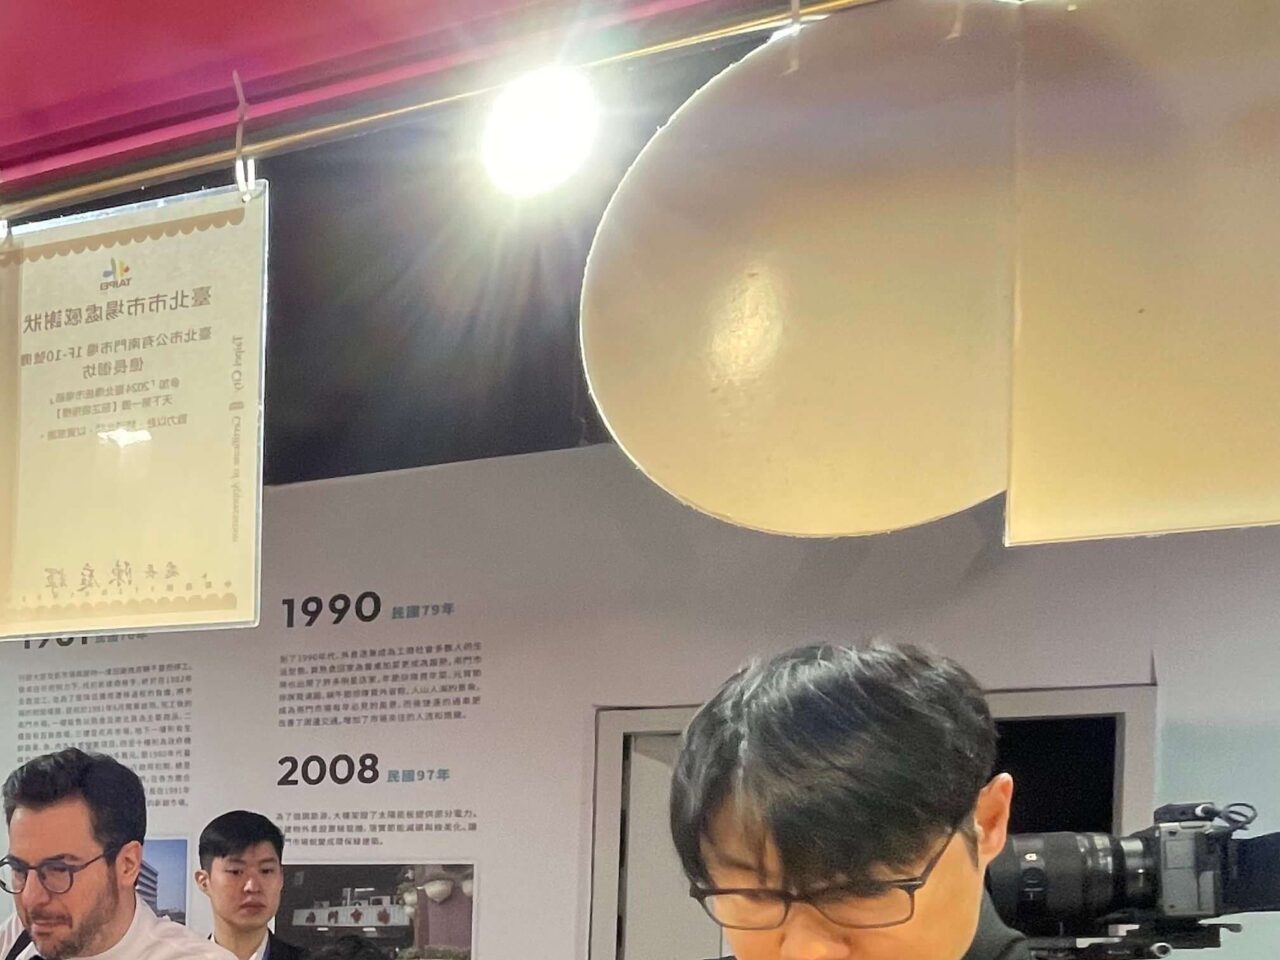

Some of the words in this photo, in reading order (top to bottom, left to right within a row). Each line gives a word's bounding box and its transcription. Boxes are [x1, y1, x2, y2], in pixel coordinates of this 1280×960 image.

[282, 591, 381, 628] 1990
[391, 602, 455, 620] 民國79年
[277, 753, 380, 786] 2008
[387, 768, 451, 783] 民國97年
